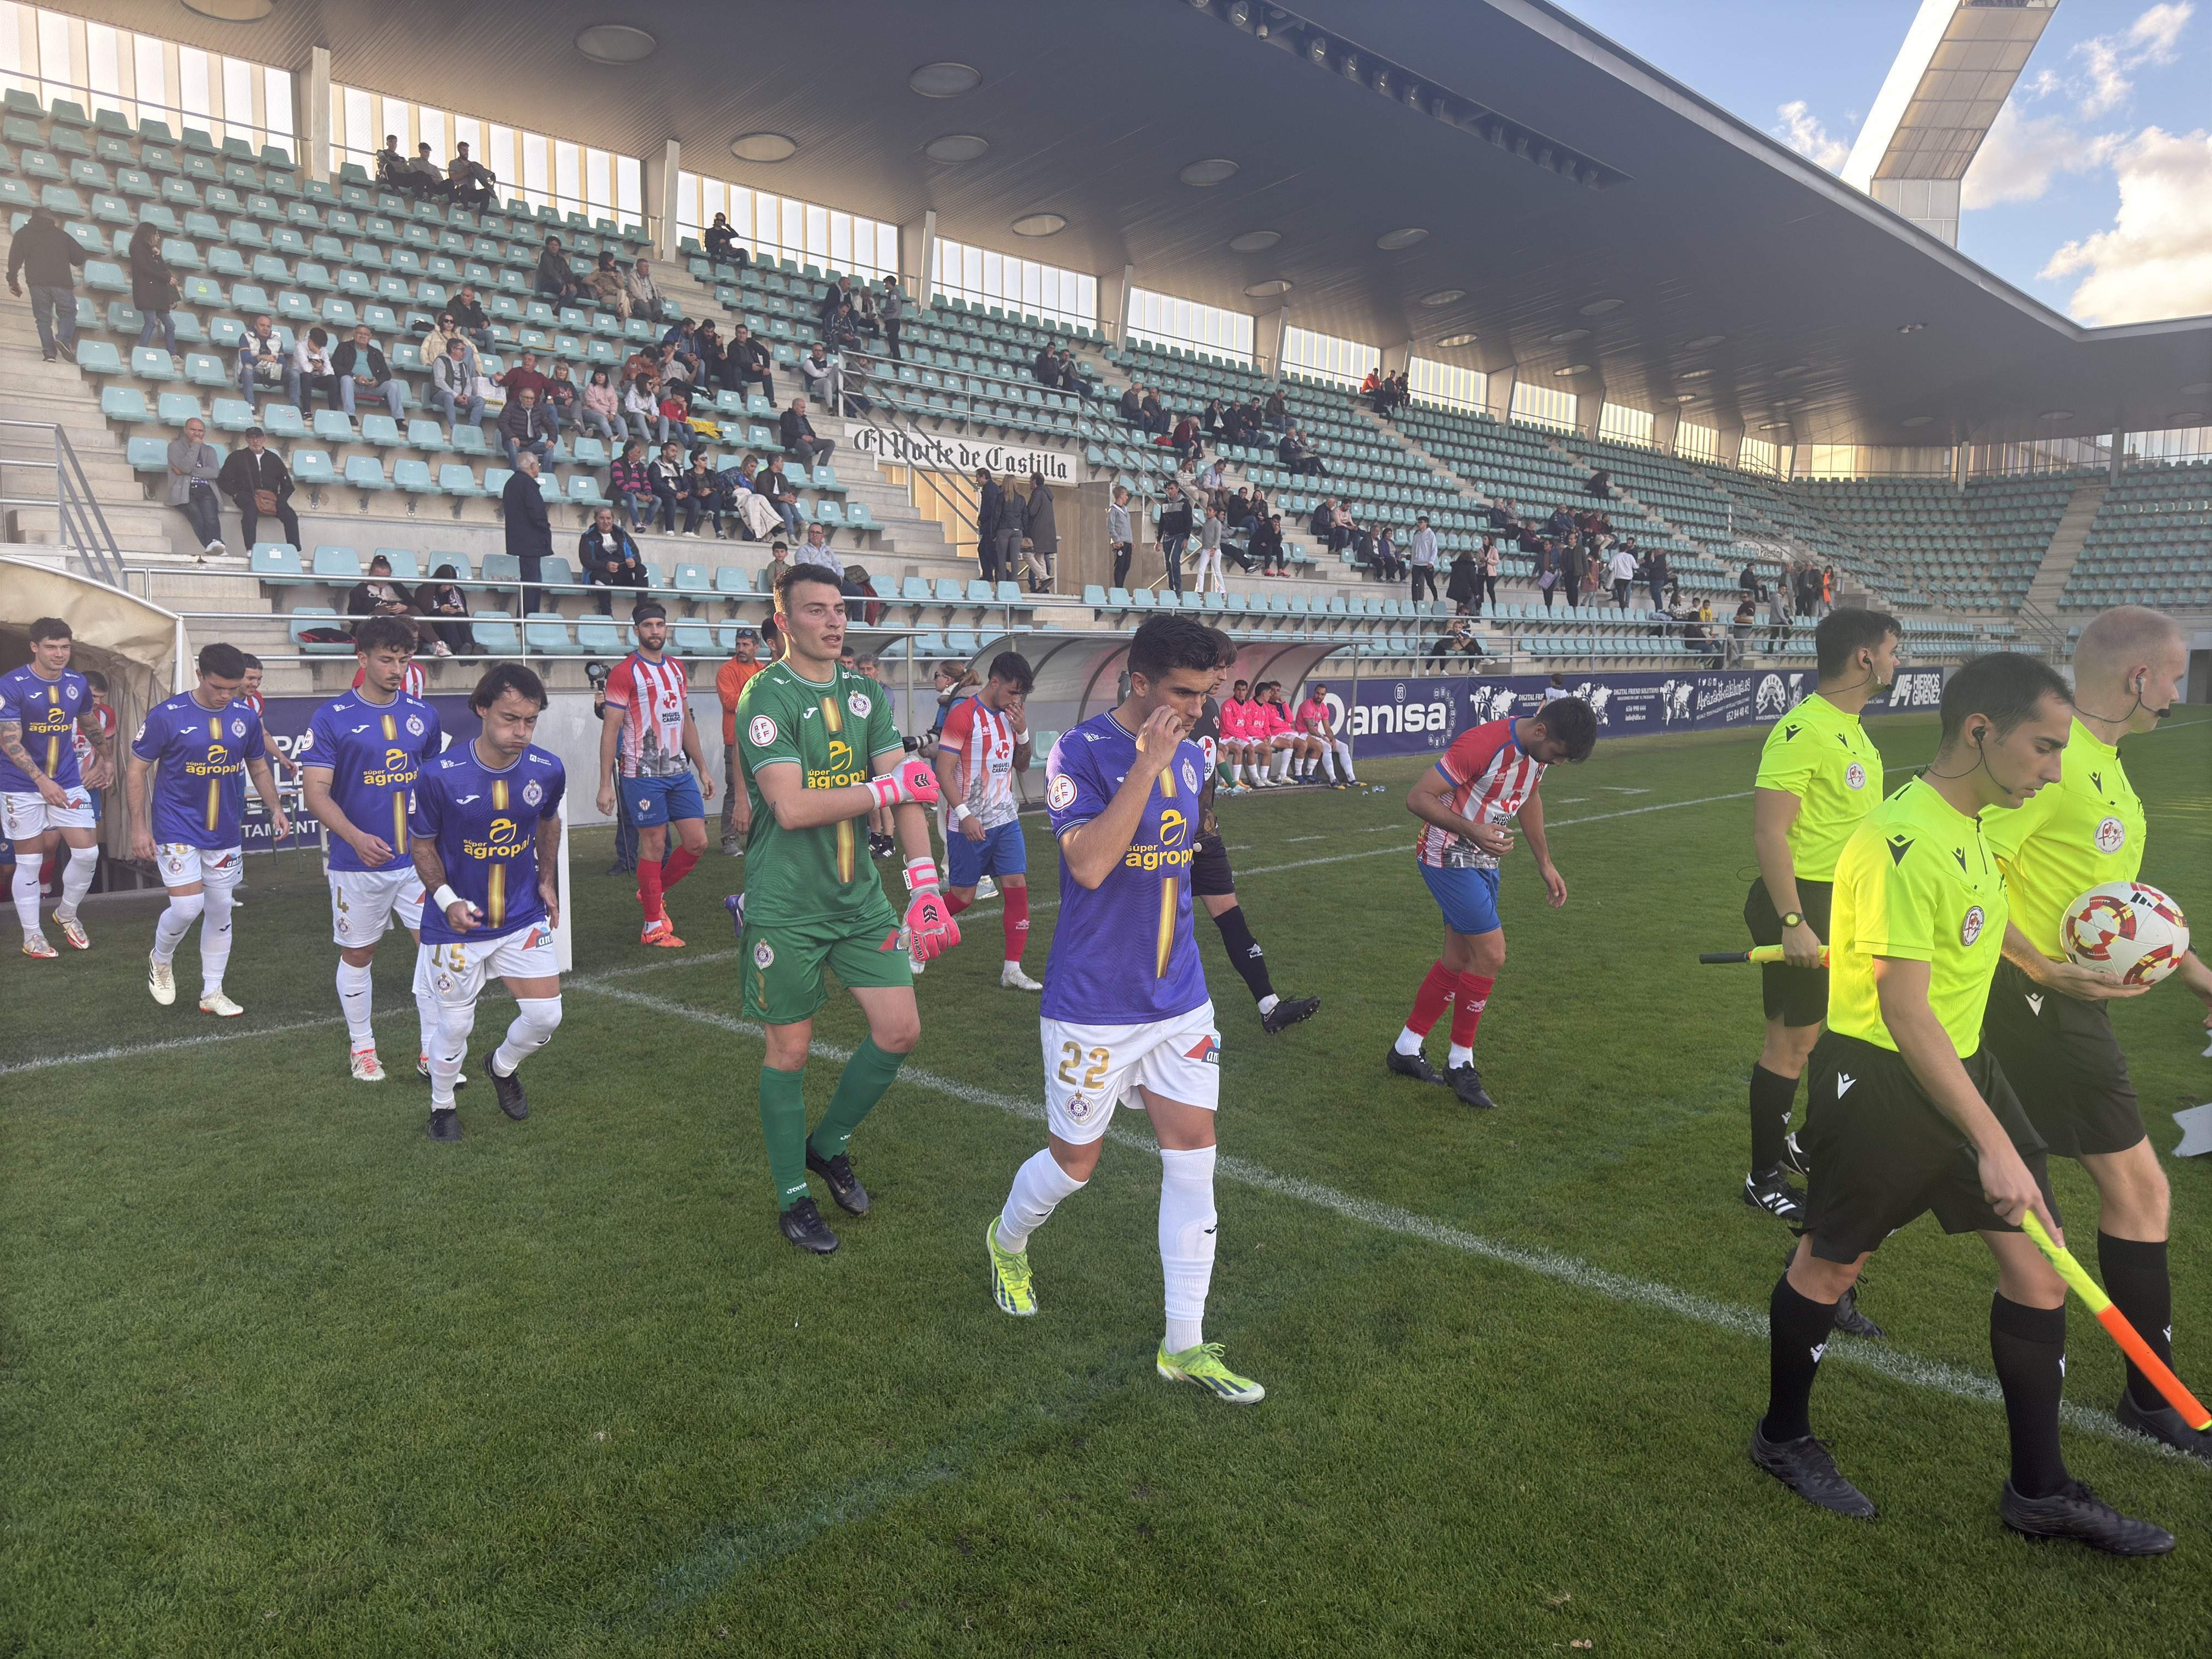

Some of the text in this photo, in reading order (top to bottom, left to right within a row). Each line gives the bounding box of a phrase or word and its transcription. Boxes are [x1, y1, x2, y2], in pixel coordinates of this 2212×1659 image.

[854, 427, 1068, 479] El Norte de Castilla
[1914, 673, 1940, 690] HIERROS
[185, 763, 240, 775] agropal
[463, 839, 488, 848] súper
[464, 833, 530, 860] agropal
[1127, 843, 1158, 853] súper
[337, 886, 349, 913] 4
[432, 943, 465, 973] 15
[1058, 1041, 1110, 1090] 22
